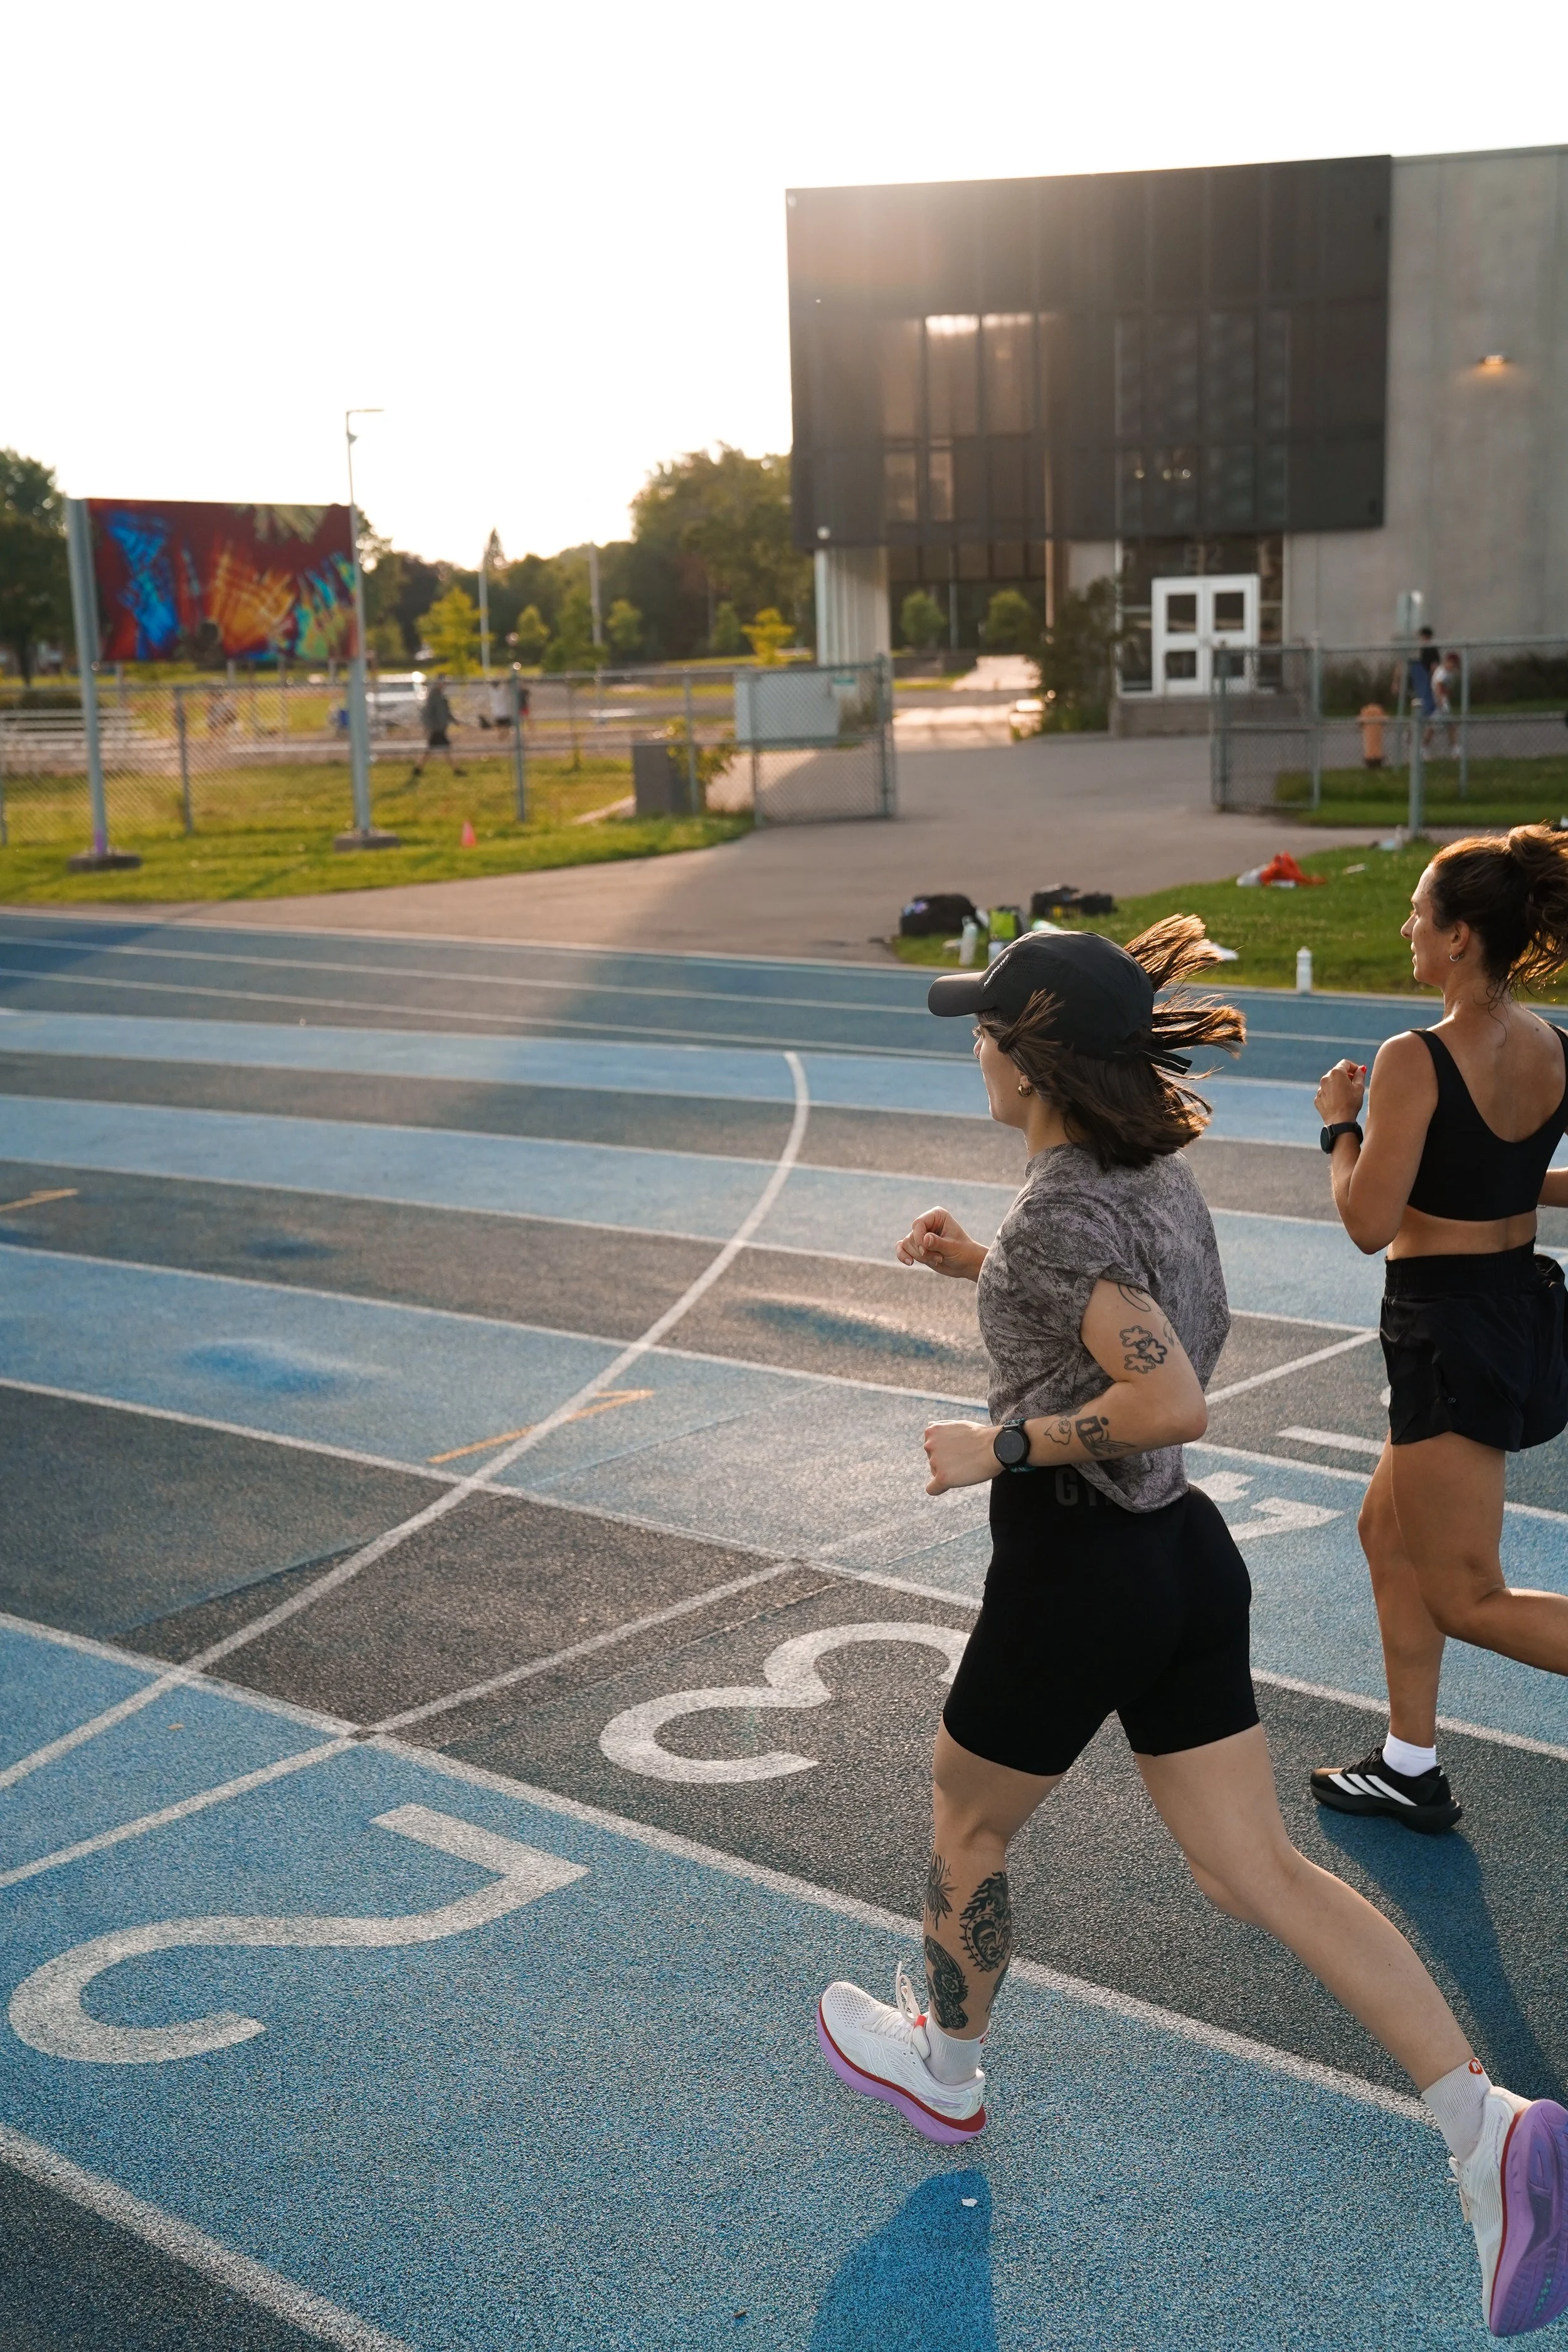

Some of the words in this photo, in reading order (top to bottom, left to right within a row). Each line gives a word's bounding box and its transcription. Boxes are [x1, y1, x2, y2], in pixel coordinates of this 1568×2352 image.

[1054, 1466, 1112, 1507] GY
[599, 1621, 971, 1784] 3
[9, 1803, 591, 2064] 2
